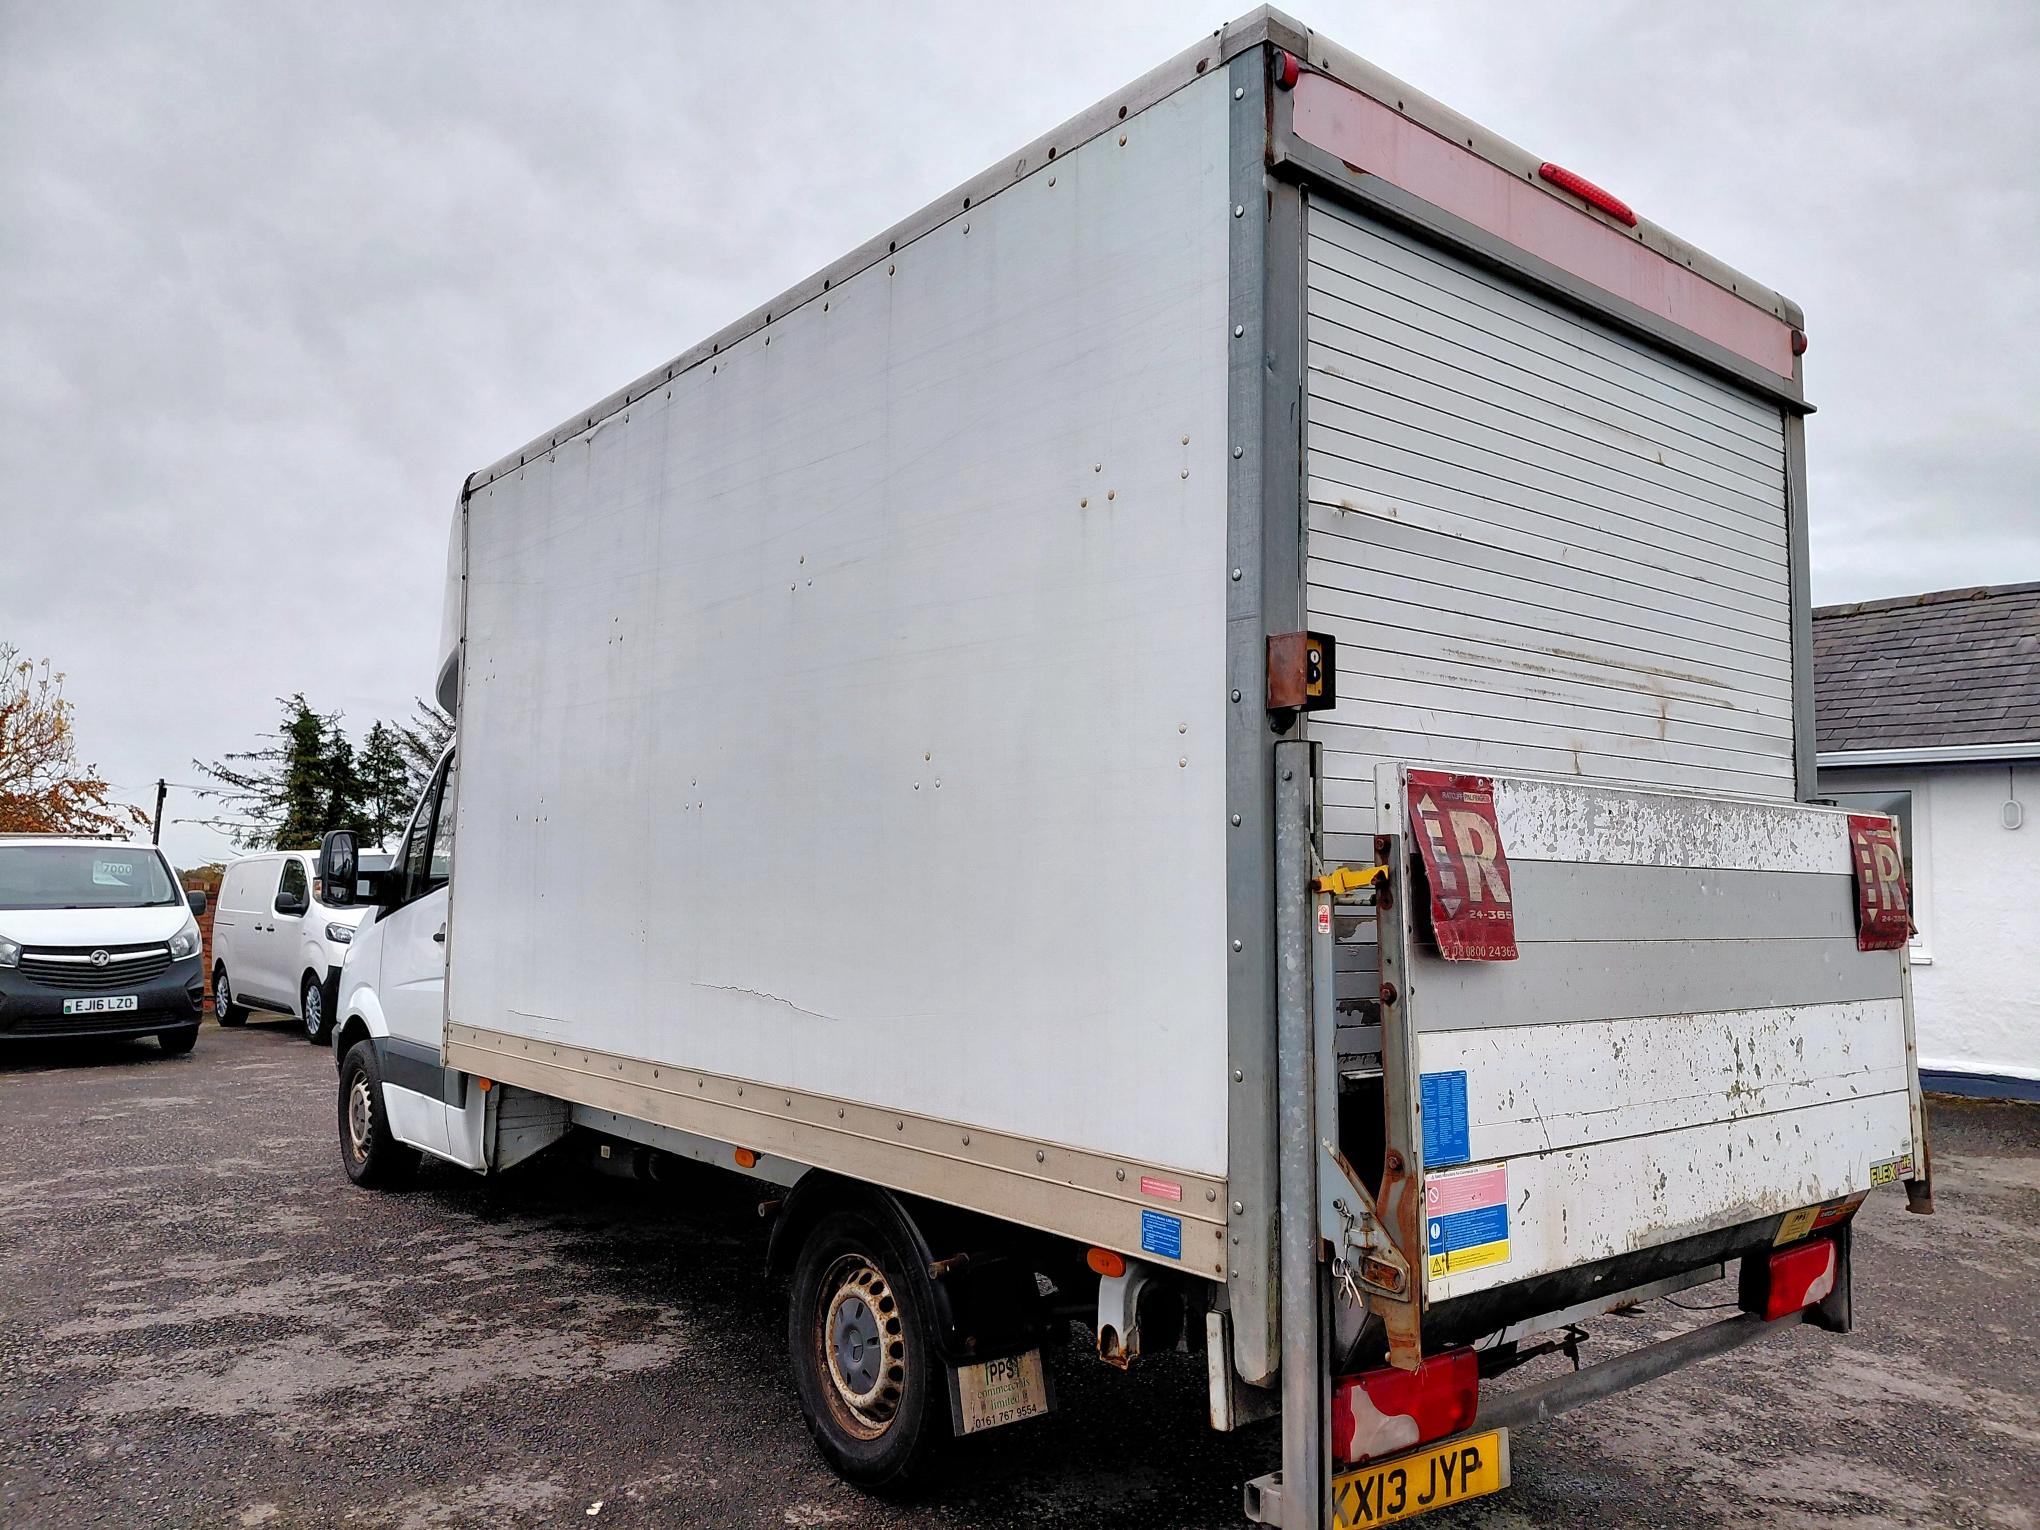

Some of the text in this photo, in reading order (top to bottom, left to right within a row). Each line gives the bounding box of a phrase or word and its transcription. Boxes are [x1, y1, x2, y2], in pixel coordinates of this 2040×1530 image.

[1449, 809, 1511, 903] R
[1469, 909, 1512, 920] 24-365
[1489, 945, 1516, 957] 24365
[75, 999, 104, 1012] EJ16
[991, 1394, 1021, 1411] limited
[975, 1403, 1037, 1429] 0161 767 9554
[1332, 1446, 1479, 1529] KX13 JYP
